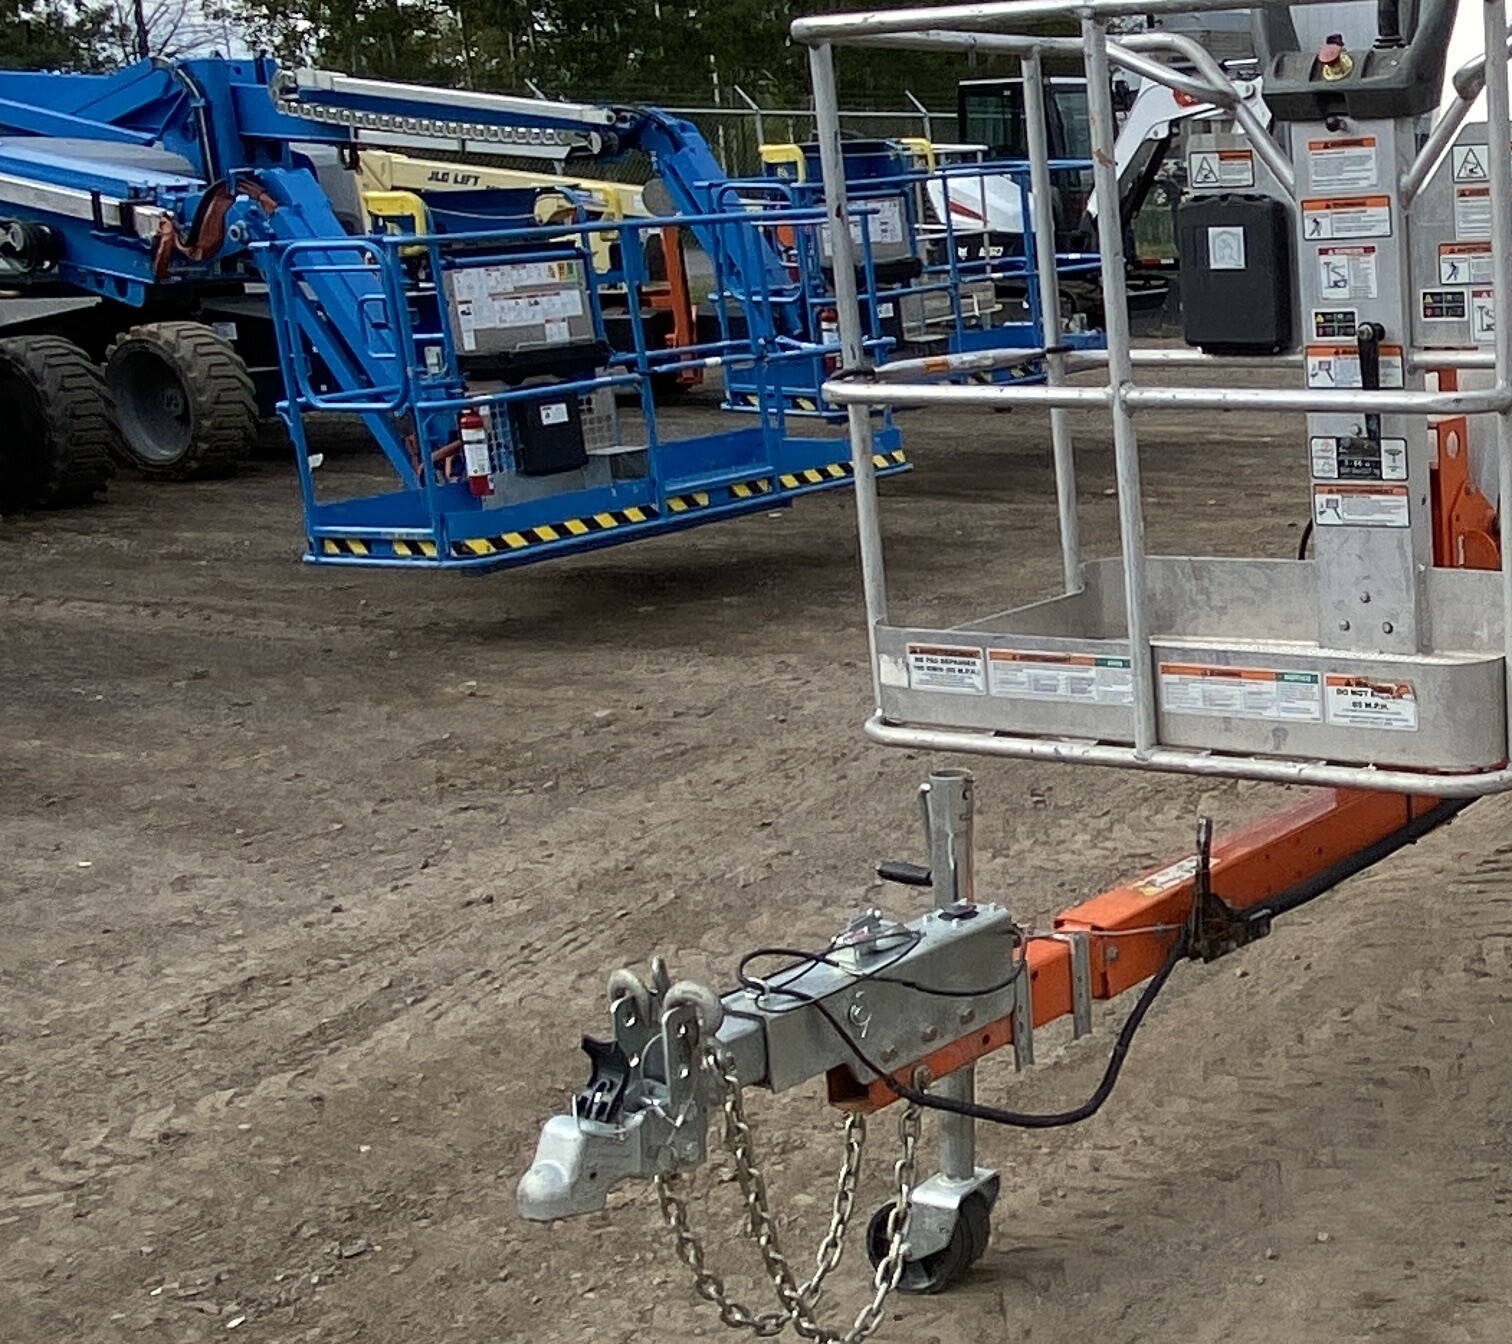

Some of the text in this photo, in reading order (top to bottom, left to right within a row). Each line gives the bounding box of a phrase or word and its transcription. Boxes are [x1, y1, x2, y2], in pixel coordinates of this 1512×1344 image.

[427, 170, 480, 186] JLG LIFT
[1336, 687, 1349, 696] DO
[1351, 688, 1368, 697] NOT
